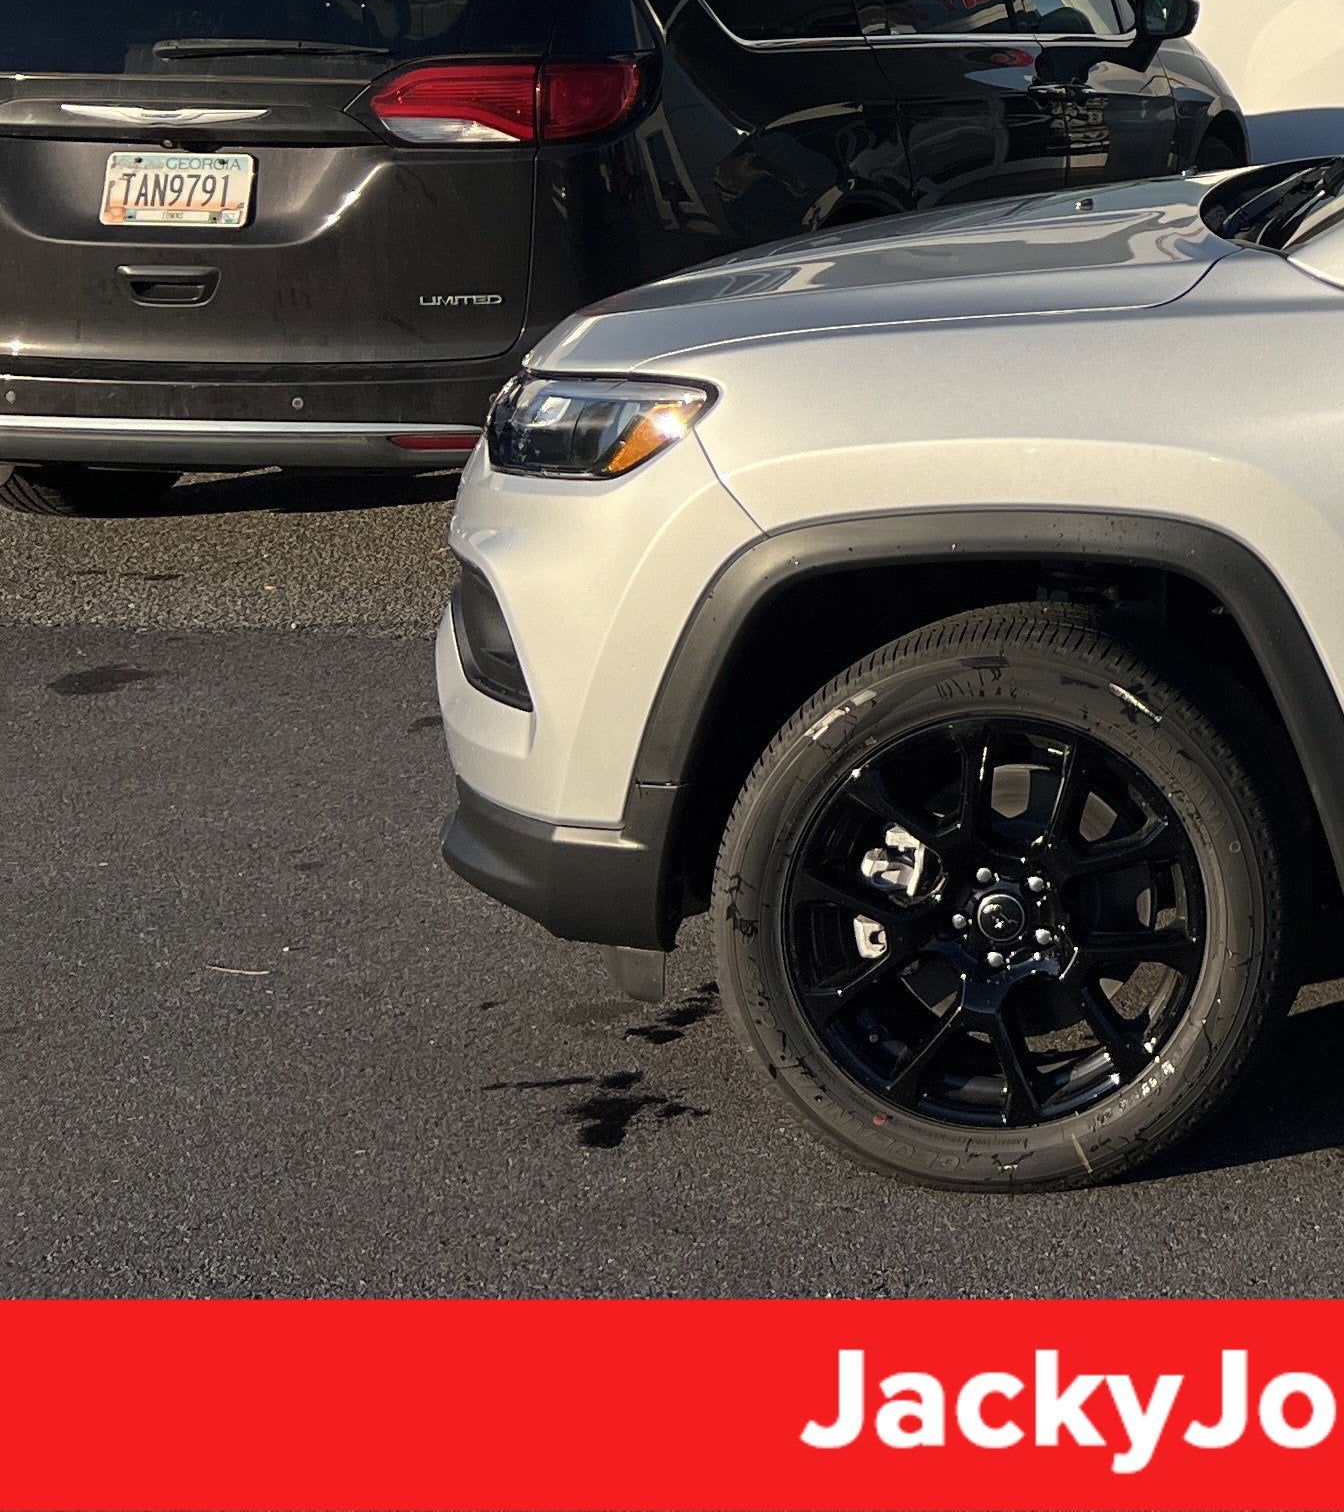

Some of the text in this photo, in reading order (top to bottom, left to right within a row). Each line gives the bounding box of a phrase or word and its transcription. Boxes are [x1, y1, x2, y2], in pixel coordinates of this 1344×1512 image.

[165, 157, 242, 171] GEORGIA
[121, 172, 230, 208] TAN9791
[419, 294, 503, 306] LIMITED
